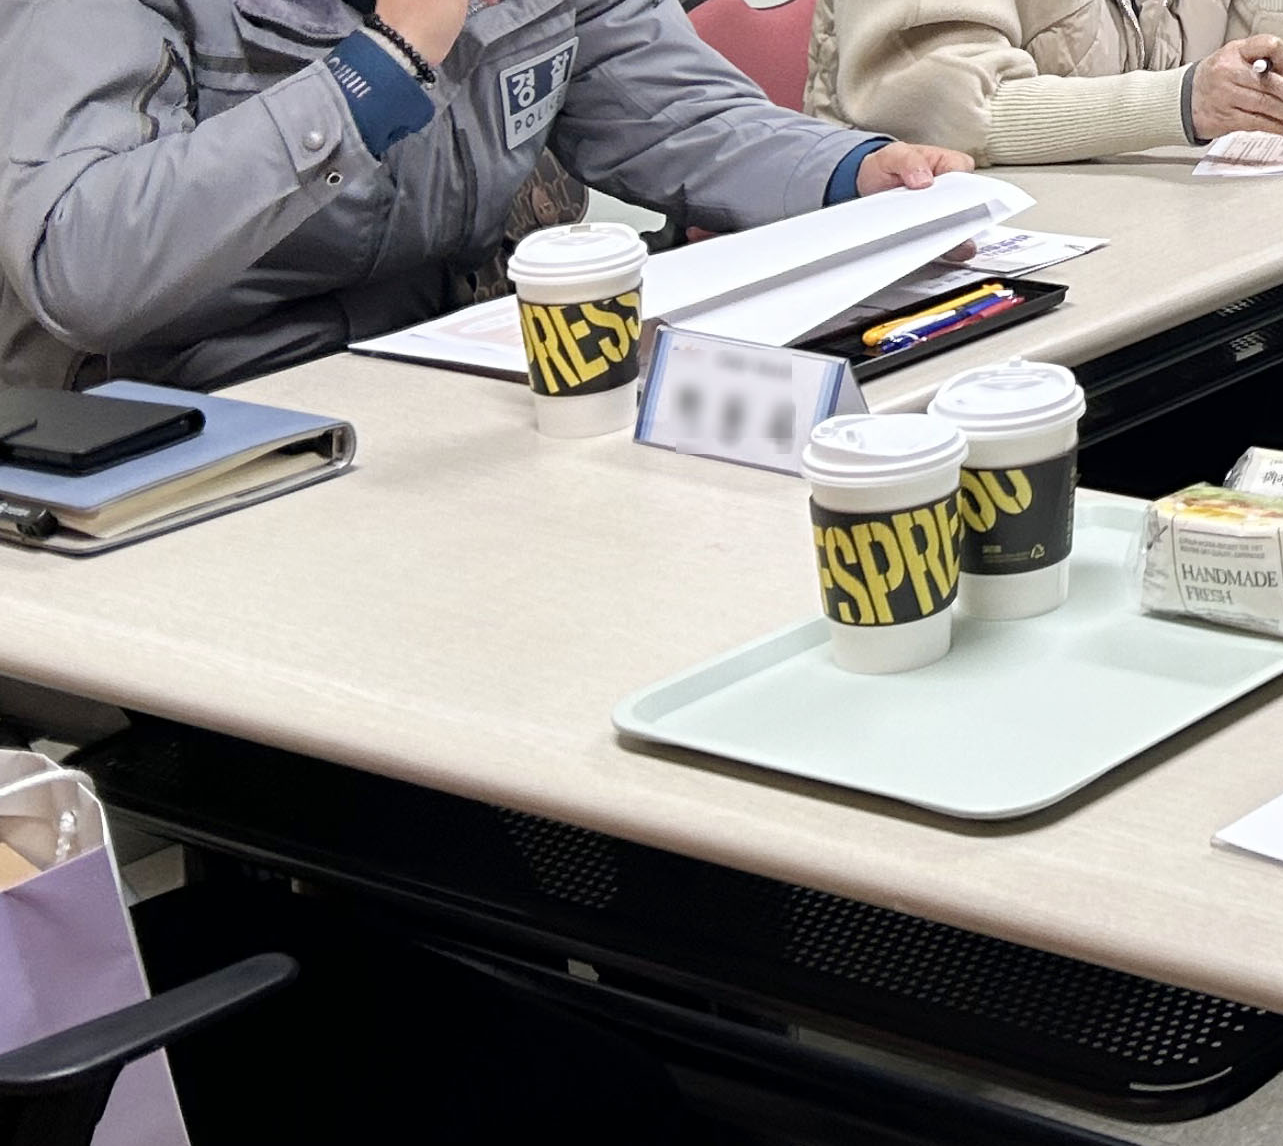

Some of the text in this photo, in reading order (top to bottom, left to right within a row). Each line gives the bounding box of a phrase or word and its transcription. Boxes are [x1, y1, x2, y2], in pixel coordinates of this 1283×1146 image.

[511, 51, 570, 108] 경찰
[1181, 562, 1279, 588] HANDMADE
[1185, 585, 1234, 605] FRESH
